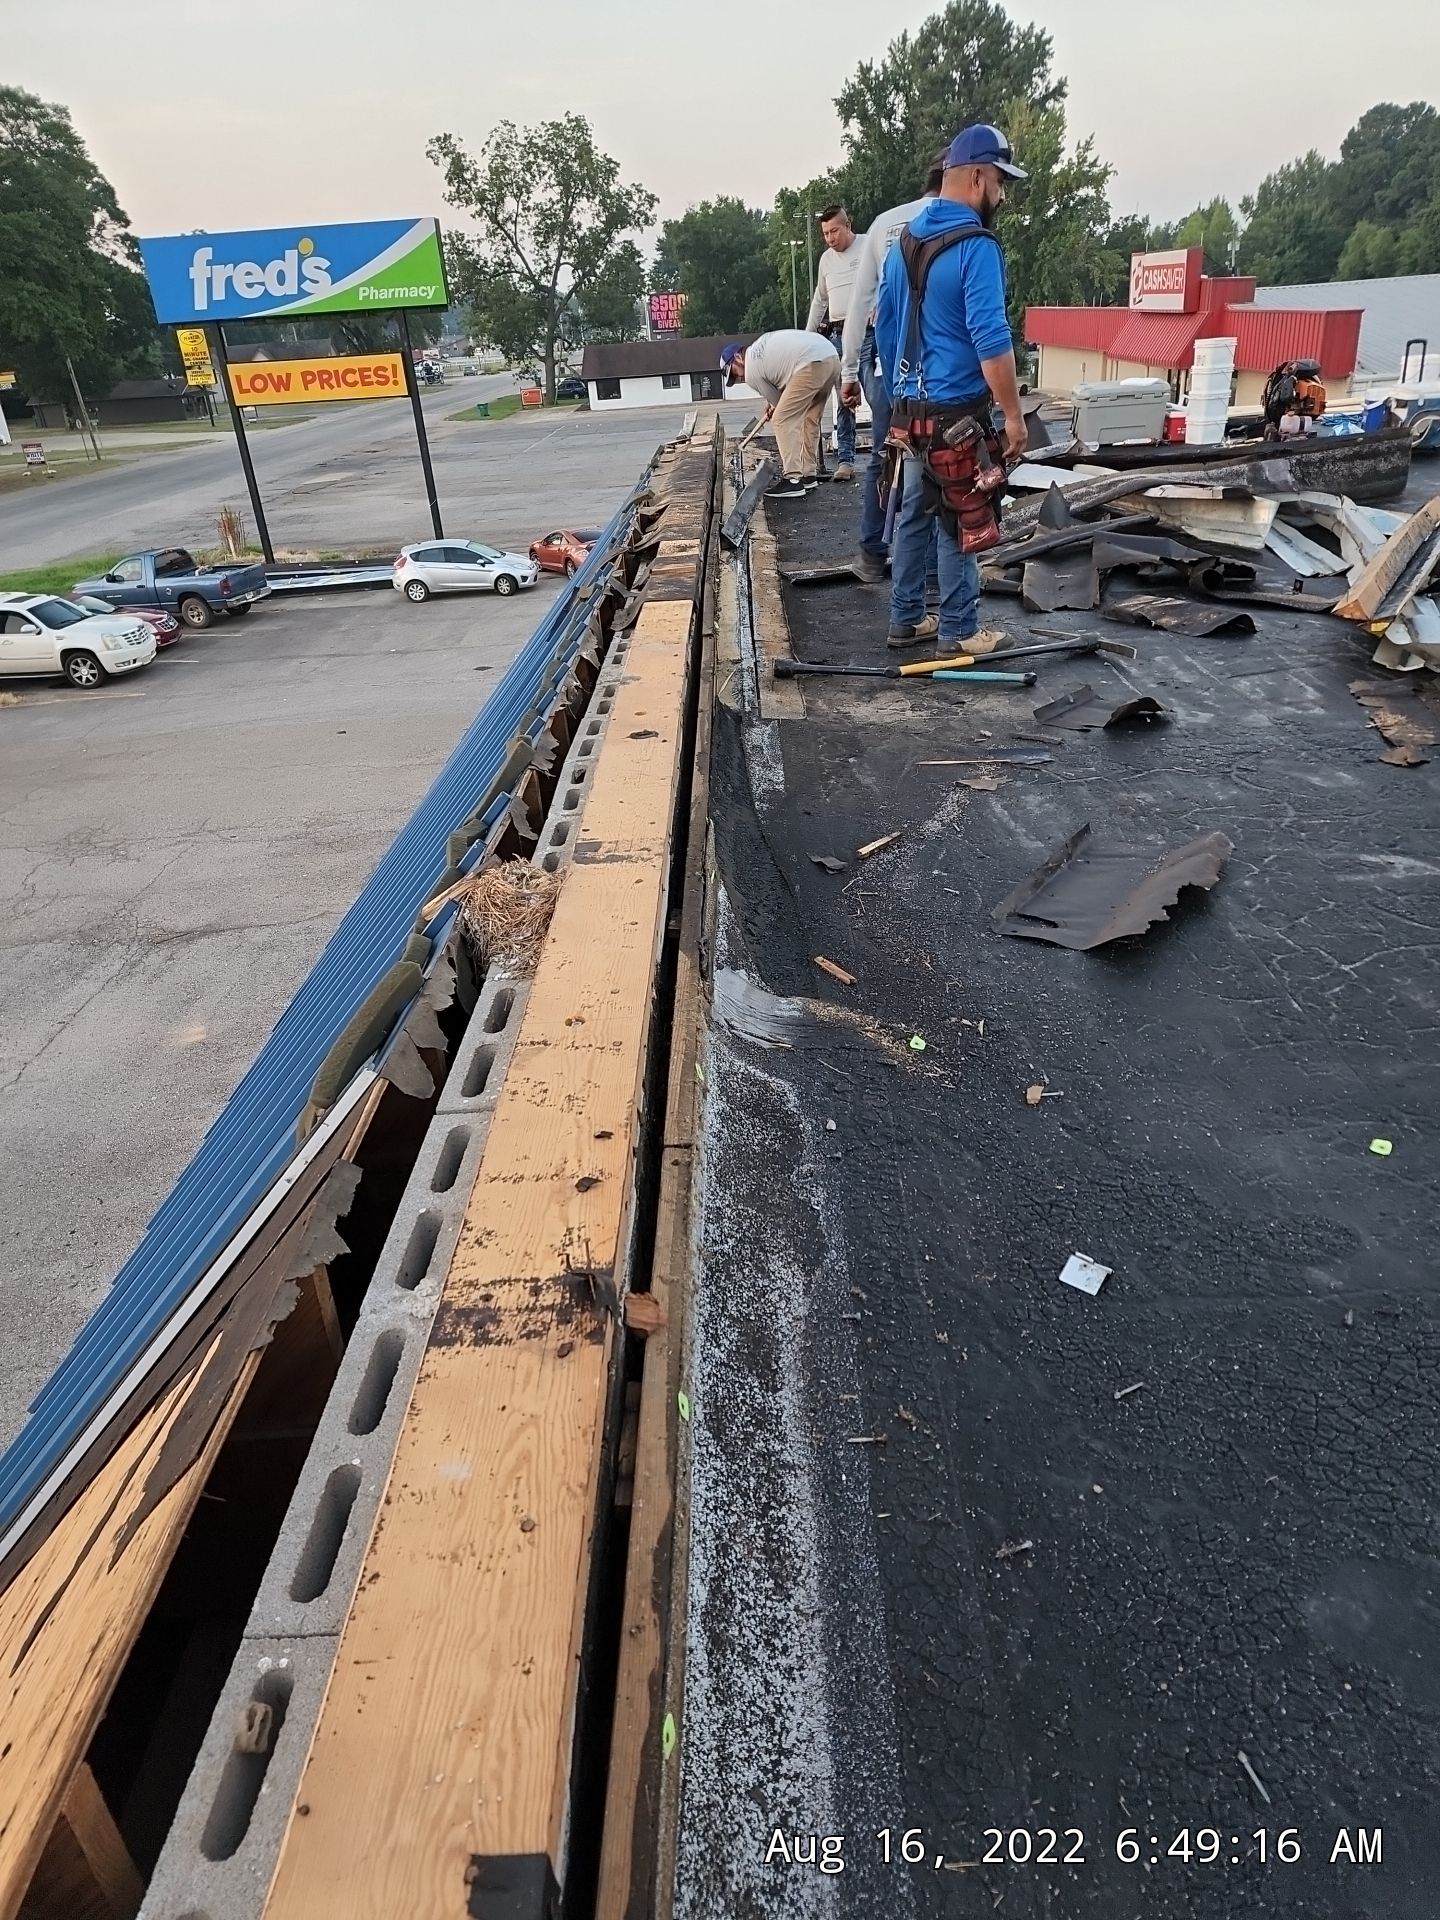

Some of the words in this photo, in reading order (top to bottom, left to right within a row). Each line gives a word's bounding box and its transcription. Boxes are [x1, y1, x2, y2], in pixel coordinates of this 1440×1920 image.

[189, 237, 332, 311] fred's
[358, 285, 437, 301] Pharmacy
[651, 294, 688, 311] $500
[652, 311, 667, 320] NEW
[235, 372, 291, 395] LOW
[301, 364, 399, 391] PRICES!
